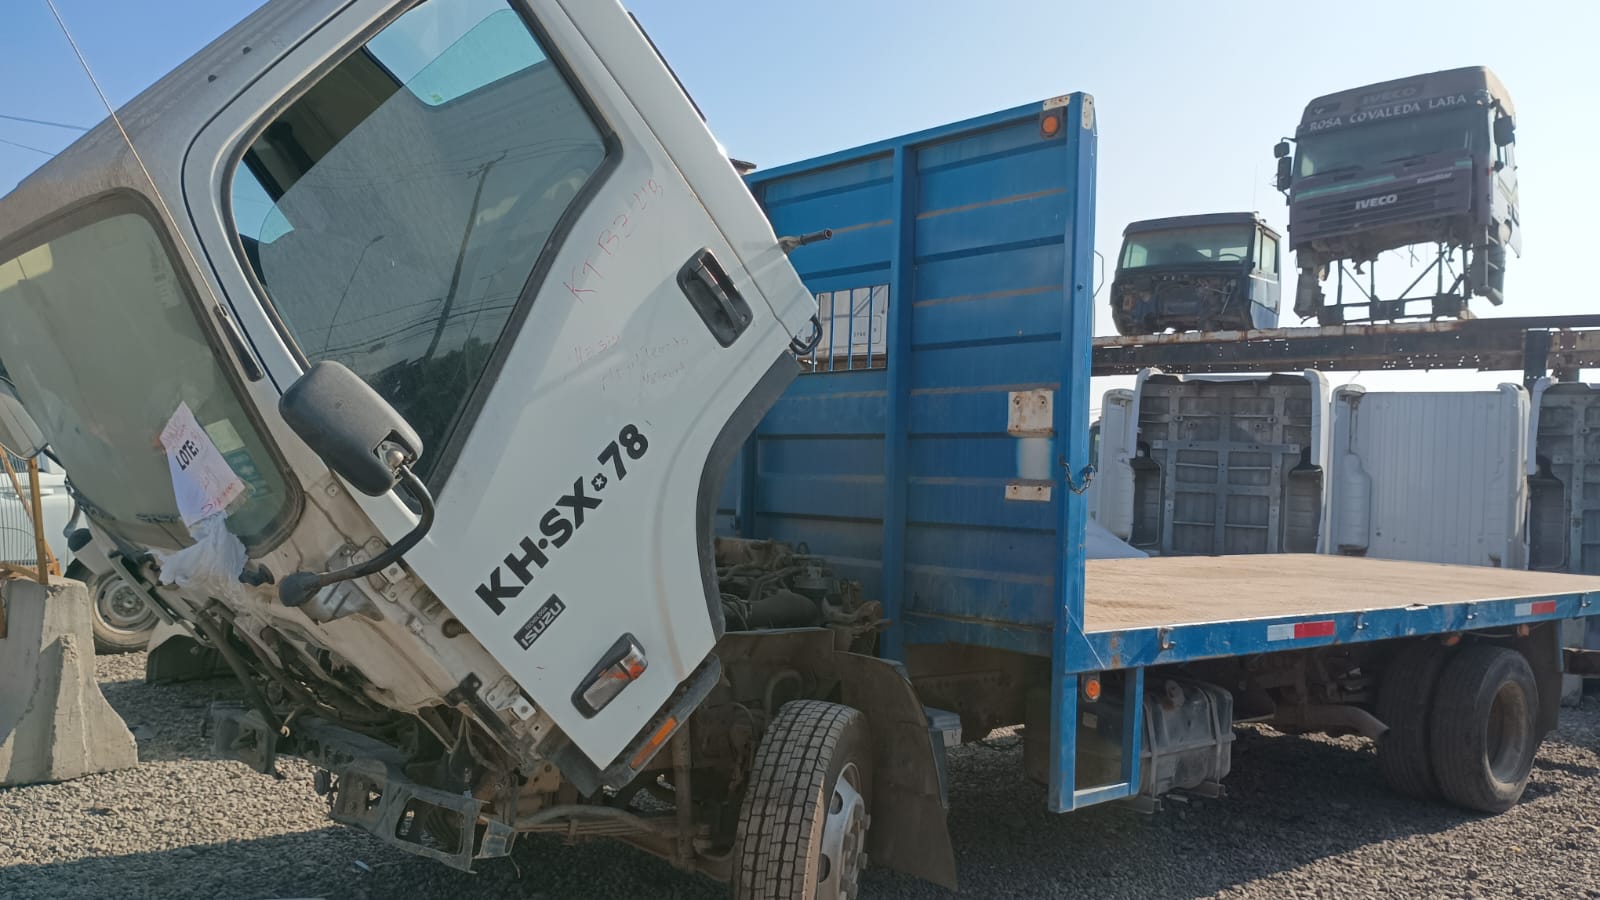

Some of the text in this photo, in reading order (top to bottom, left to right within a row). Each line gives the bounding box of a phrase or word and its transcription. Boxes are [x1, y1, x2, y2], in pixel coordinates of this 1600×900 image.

[1362, 87, 1417, 104] IVECO
[1309, 94, 1467, 132] ROSA COVALEDA LARA
[1355, 194, 1398, 210] IVECO
[174, 439, 199, 471] LOTE:
[520, 601, 563, 648] ISUZU
